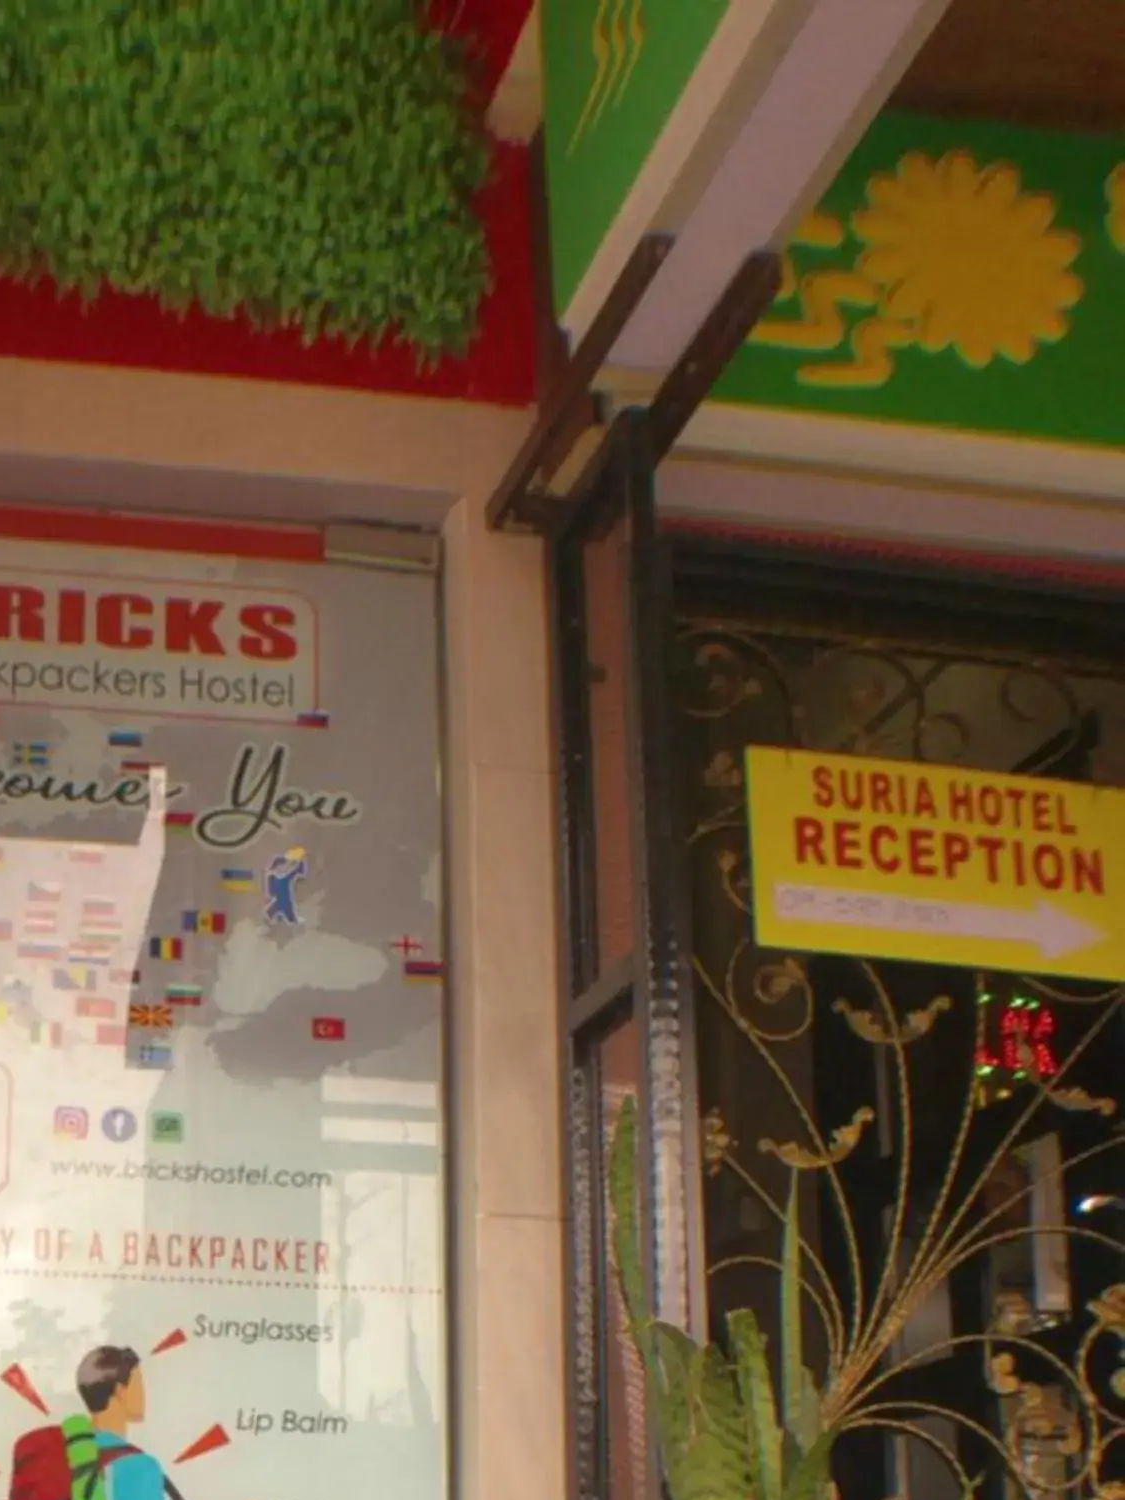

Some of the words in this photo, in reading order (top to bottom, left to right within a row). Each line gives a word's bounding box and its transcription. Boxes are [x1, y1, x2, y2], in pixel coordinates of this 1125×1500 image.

[180, 668, 295, 708] Hostel
[195, 744, 359, 848] You
[812, 765, 938, 819] SURIA
[948, 780, 1079, 836] HOTEL
[794, 816, 1105, 895] RECEPTION
[50, 1156, 333, 1190] www.brickshostel.com
[33, 1228, 73, 1263] OF
[88, 1232, 105, 1264] A
[122, 1231, 332, 1276] BACKPACKER
[193, 1313, 335, 1345] Sunglasses
[235, 1408, 274, 1436] Lip
[280, 1409, 349, 1435] Balm
